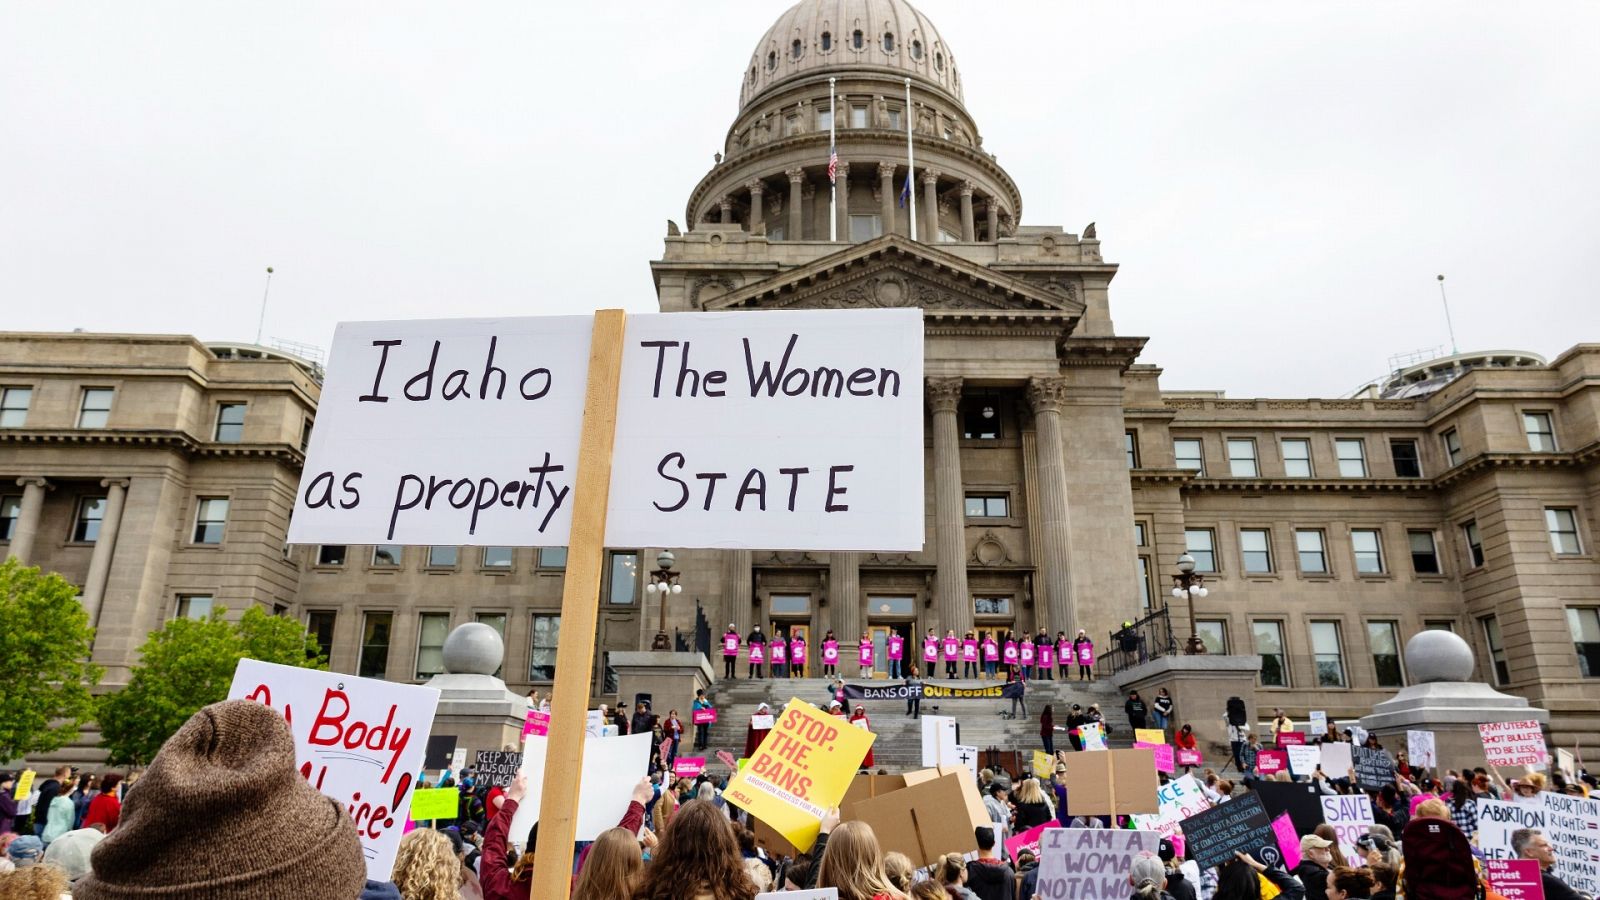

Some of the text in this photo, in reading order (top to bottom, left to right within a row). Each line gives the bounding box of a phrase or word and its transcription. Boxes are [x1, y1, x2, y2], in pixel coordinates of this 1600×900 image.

[359, 333, 901, 402] Idaho The Women
[304, 452, 855, 541] as property STATE
[864, 686, 1003, 698] BANS OFF OUR BODIES
[782, 709, 838, 752] STOP.
[1480, 720, 1538, 732] IF MY UTERUS
[308, 688, 412, 784] Body
[1481, 732, 1544, 744] SHOT BULLETS
[477, 751, 501, 763] KEEP
[769, 731, 812, 770] THE.
[1503, 746, 1514, 754] BE
[1516, 745, 1536, 753] LESS
[475, 763, 498, 774] LAWS
[1488, 756, 1538, 767] REGULATED
[475, 774, 491, 786] MY
[751, 753, 813, 802] BANS.
[730, 790, 753, 806] ACLU
[747, 775, 824, 818] ABORTION ACCESS FOR ALL
[1545, 795, 1598, 816] ABORTION
[1324, 797, 1373, 821] SAVE
[1480, 804, 1545, 828] ABORTION
[1213, 821, 1226, 832] BUT
[1231, 805, 1263, 824] COLLECTION
[1550, 814, 1586, 831] RIGHTS
[1048, 830, 1144, 851] I AM A
[1192, 843, 1200, 852] OF
[1230, 823, 1250, 836] SMALL
[1549, 831, 1600, 850] WOMENS
[1553, 844, 1589, 861] RIGHTS
[1064, 853, 1132, 874] WOMA
[1489, 861, 1509, 869] this
[1557, 859, 1597, 876] HUMAN
[1491, 871, 1520, 880] priest
[1493, 886, 1524, 896] is pro-
